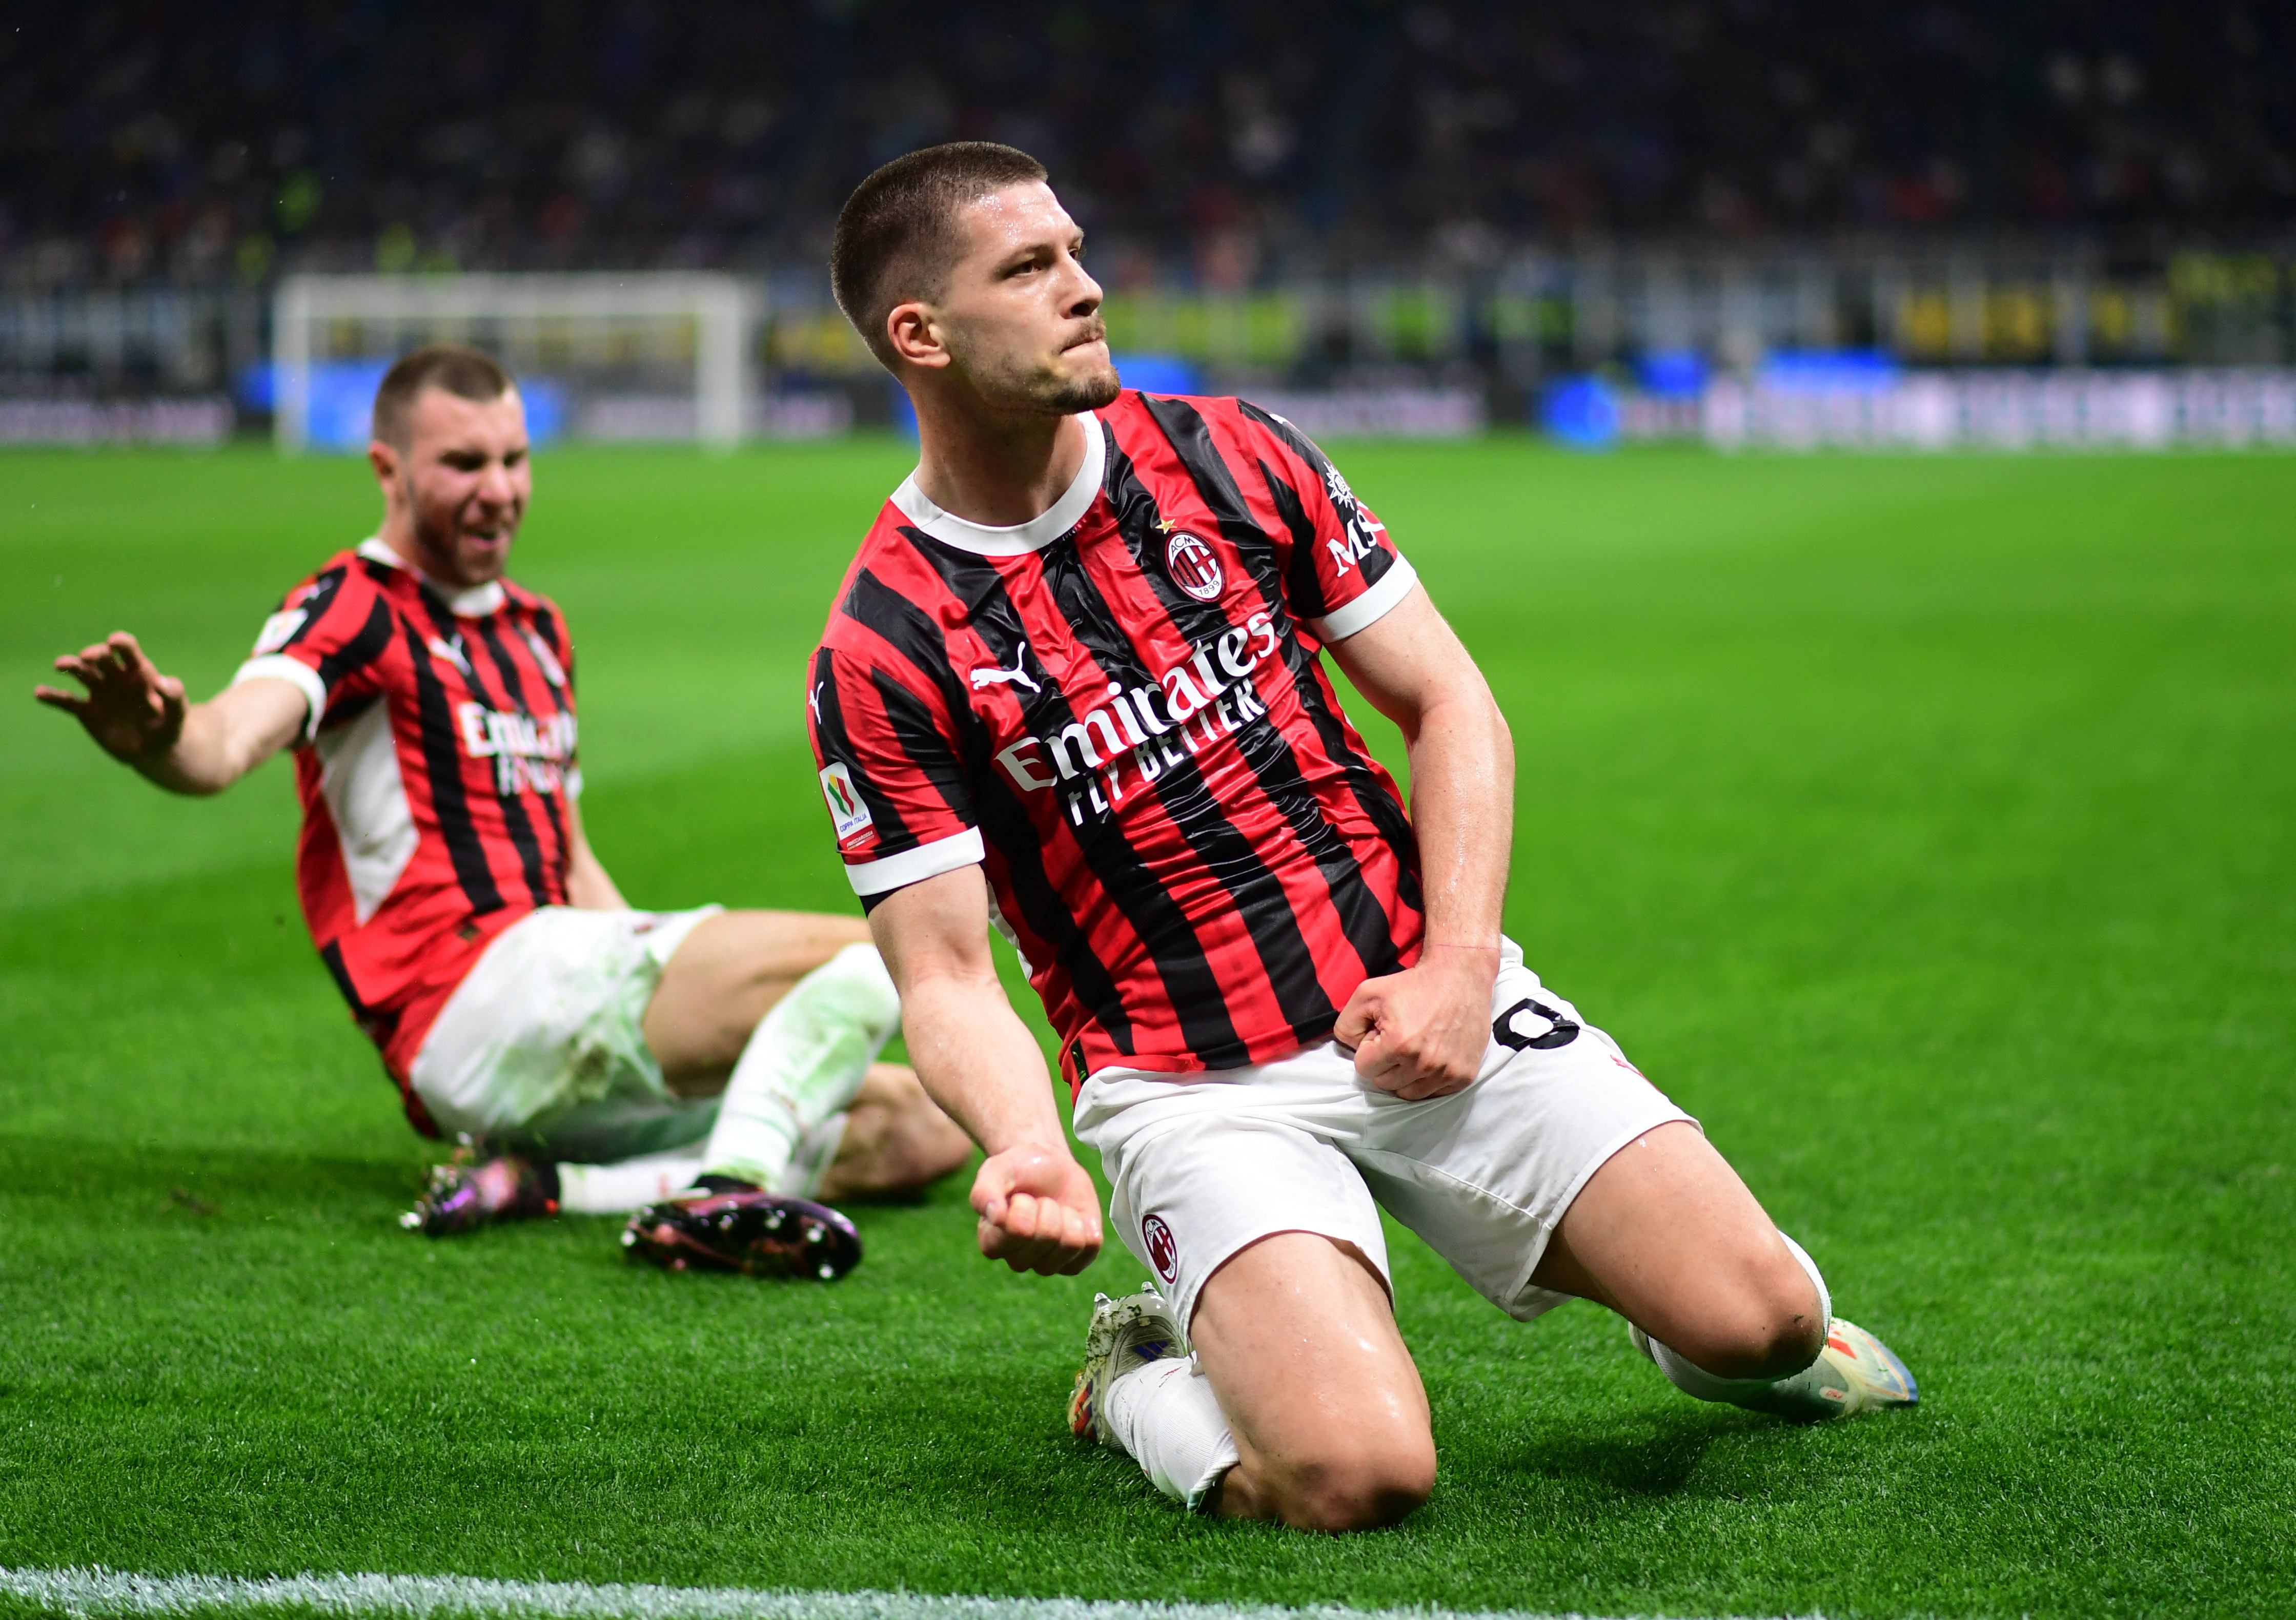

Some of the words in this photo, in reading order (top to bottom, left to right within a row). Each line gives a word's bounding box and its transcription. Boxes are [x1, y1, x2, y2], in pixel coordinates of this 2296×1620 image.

[1171, 536, 1196, 558] ACM
[1198, 580, 1220, 596] 1899
[993, 612, 1275, 792] Emirates
[1068, 760, 1123, 826] FLY
[840, 821, 854, 832] COPPA
[854, 813, 867, 824] ITALIA
[1147, 1220, 1159, 1244] ACM
